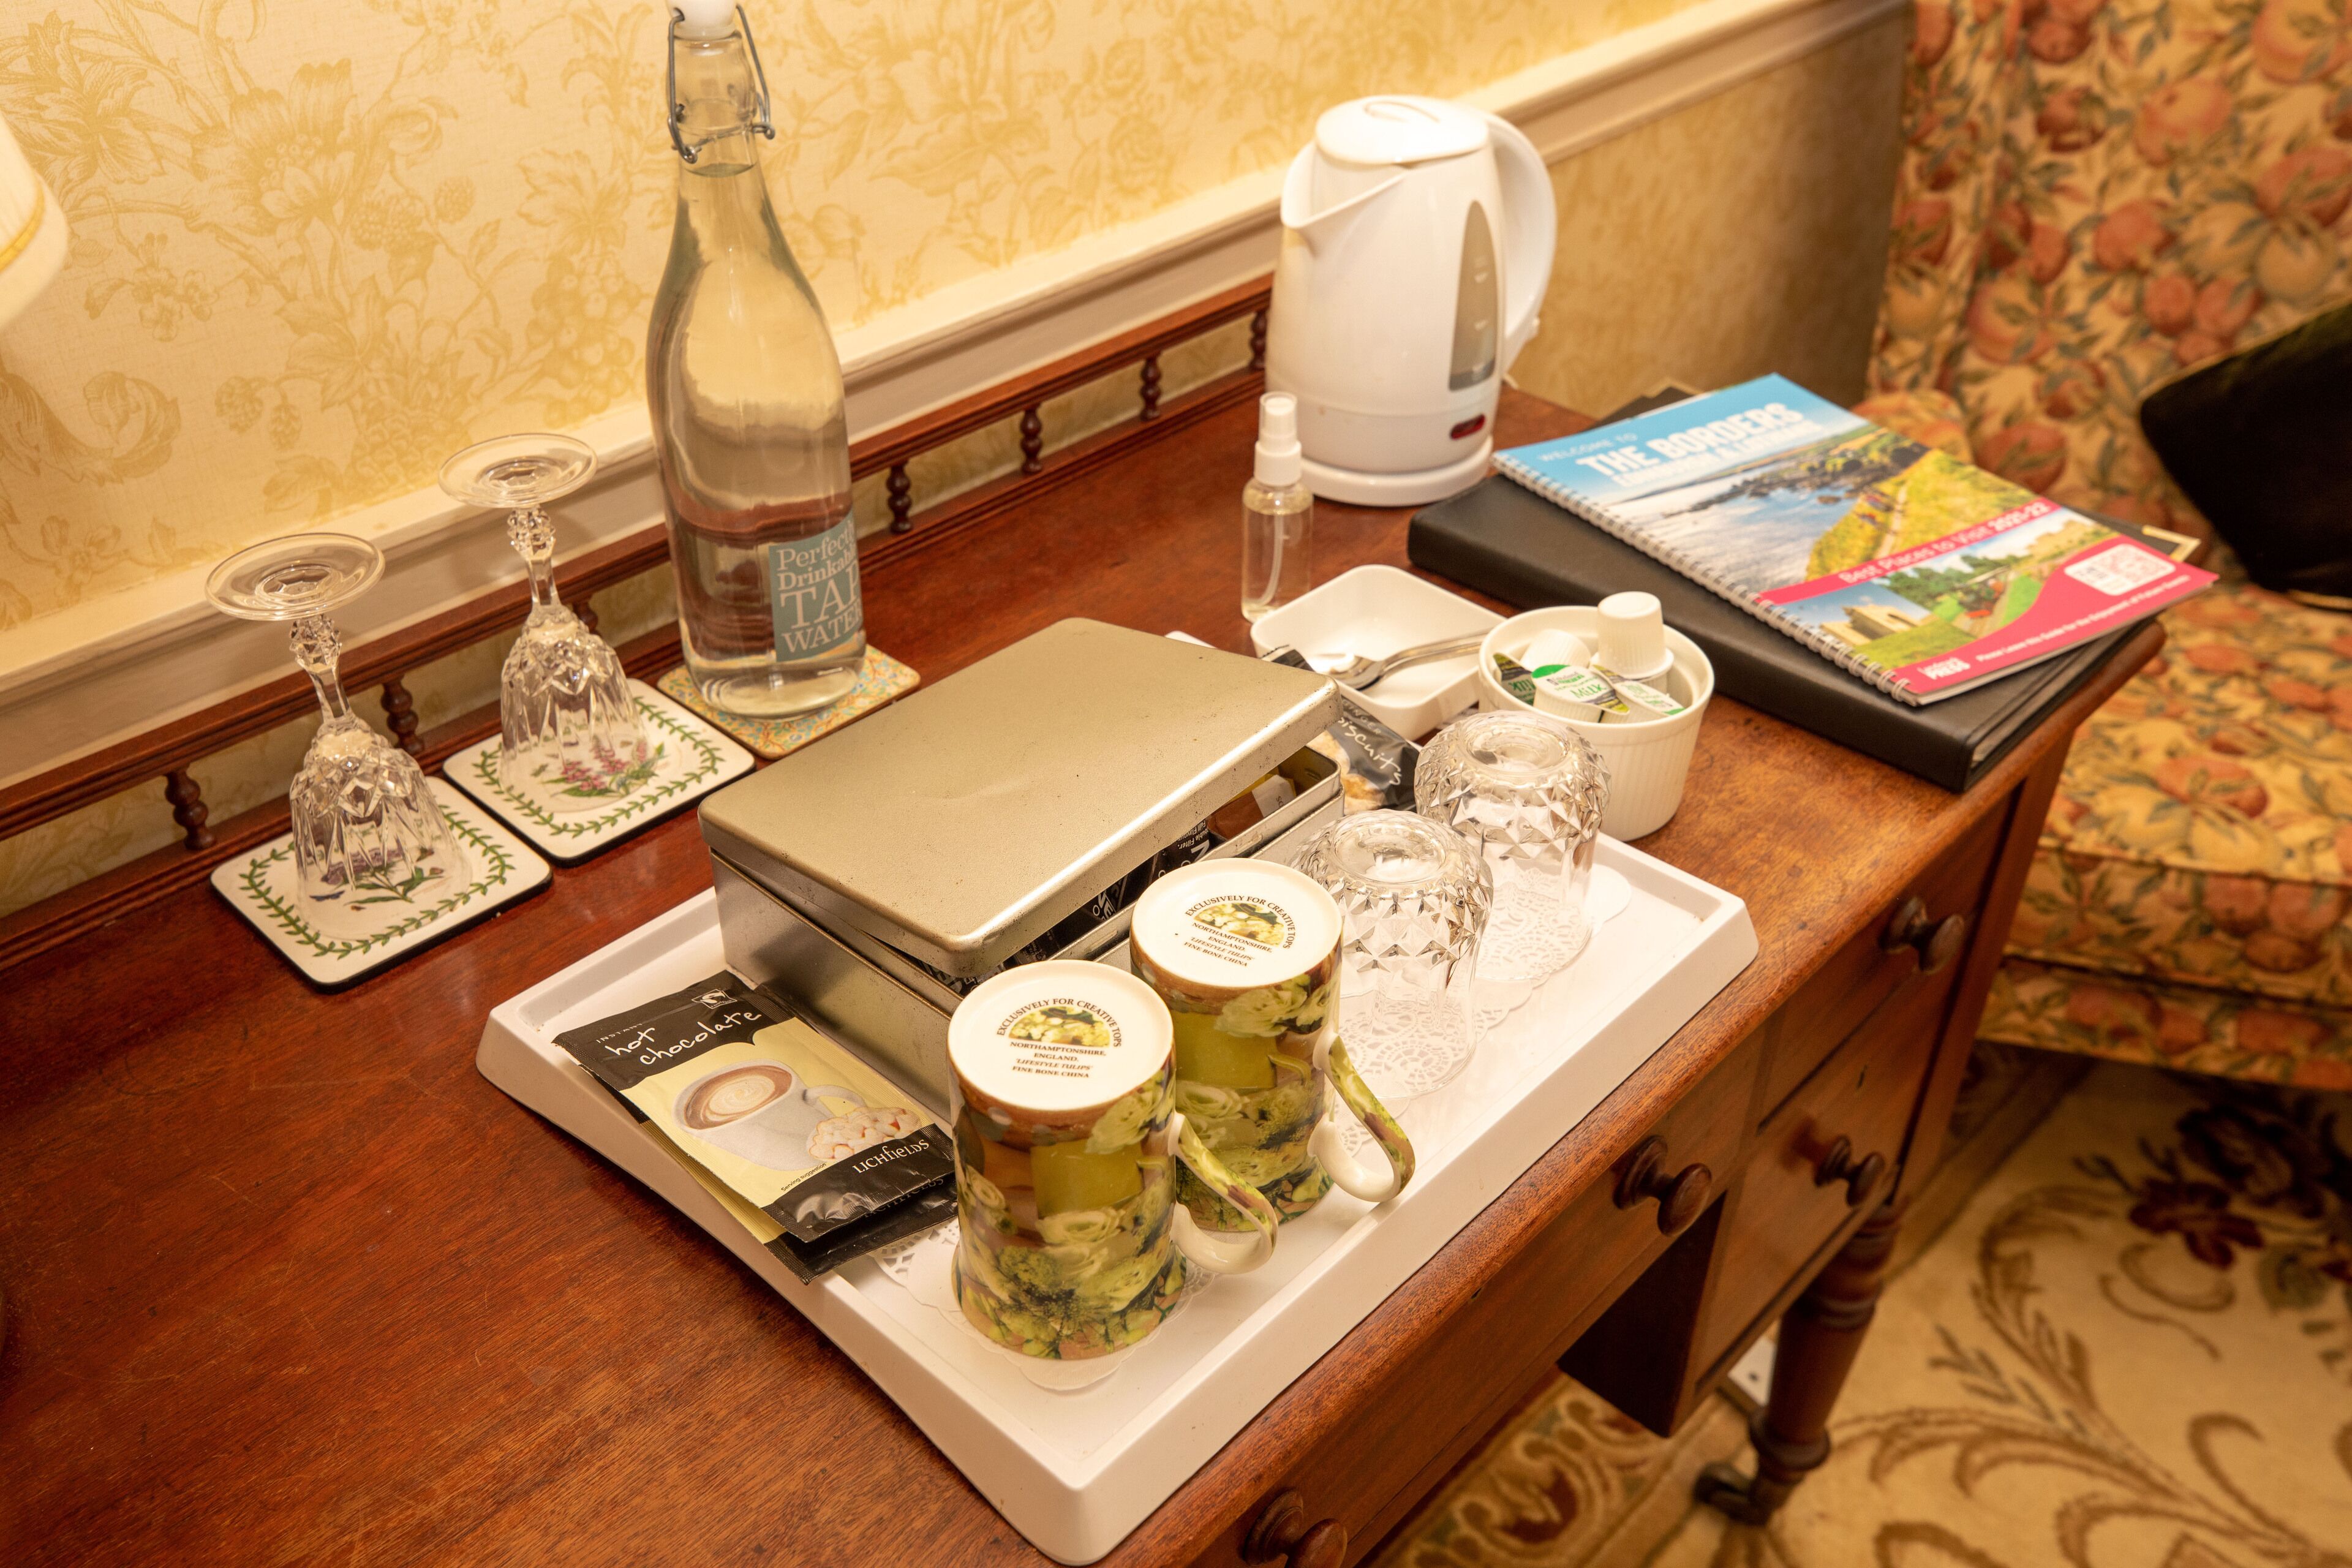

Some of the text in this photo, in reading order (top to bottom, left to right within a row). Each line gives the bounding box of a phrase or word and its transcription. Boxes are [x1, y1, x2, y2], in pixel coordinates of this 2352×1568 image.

[1539, 439, 1615, 462] WELCOME
[1575, 402, 1804, 477] THE BORDERS
[776, 521, 856, 571] Perfectl
[1838, 502, 2051, 583] Best Places to Visit 2021-22
[777, 543, 858, 590] Drinkabl
[780, 559, 861, 630] TAP
[1570, 684, 1607, 698] Milk
[1195, 828, 1209, 842] ouble
[1197, 820, 1206, 830] Full
[1177, 837, 1195, 850] Filter.
[1185, 895, 1296, 949] EXCLUSIVELY FOR CREATIVE TOPS
[1184, 941, 1248, 967] FINE BONE CHINA
[596, 1023, 643, 1044] INSTANT
[997, 999, 1050, 1036] EXCLUSIVELY
[1076, 1000, 1117, 1028] CREATIVE
[1112, 1026, 1122, 1047] TOPS
[605, 1027, 655, 1056] hot
[639, 1012, 761, 1065] chocolate
[781, 1163, 827, 1192] Serving suggestion
